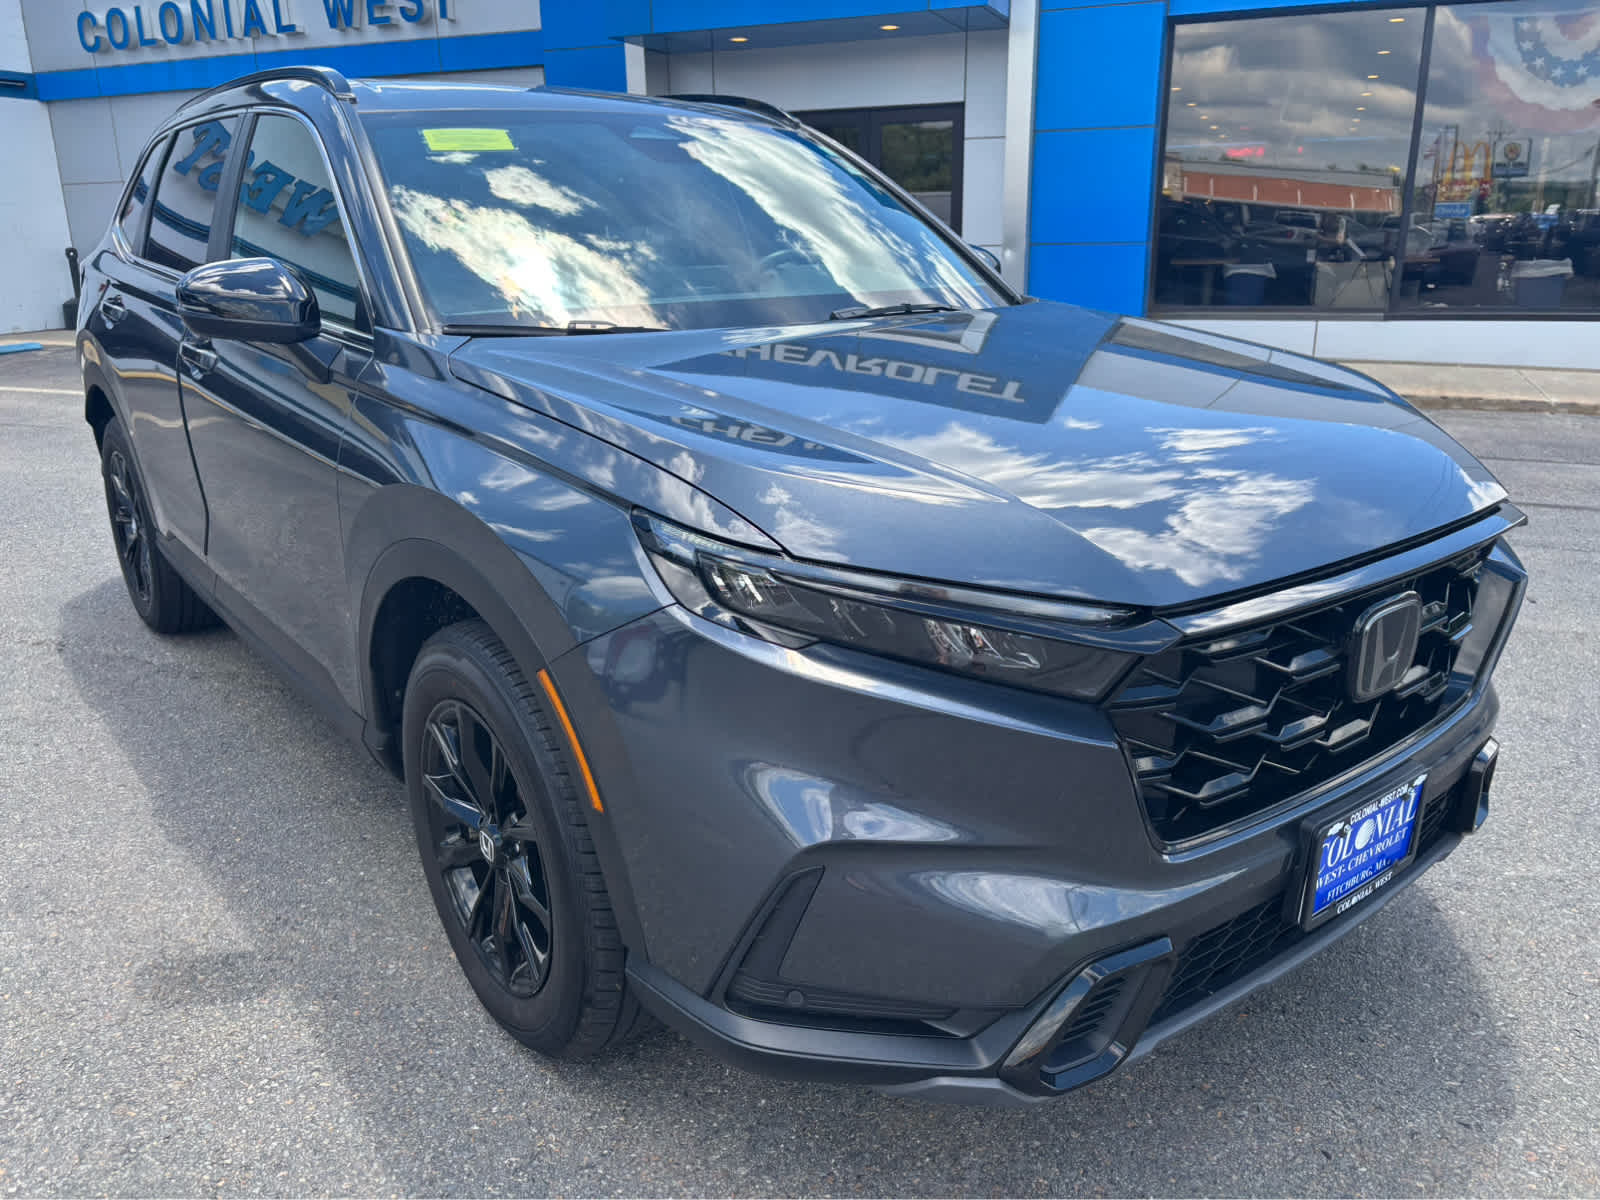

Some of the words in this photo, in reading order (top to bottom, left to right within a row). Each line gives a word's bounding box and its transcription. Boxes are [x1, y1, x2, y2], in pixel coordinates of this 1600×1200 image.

[77, 0, 297, 53] COLONIAL
[1348, 827, 1408, 871] CHEVROLET
[1337, 887, 1374, 914] COLONIAL
[1375, 872, 1393, 889] WEST
